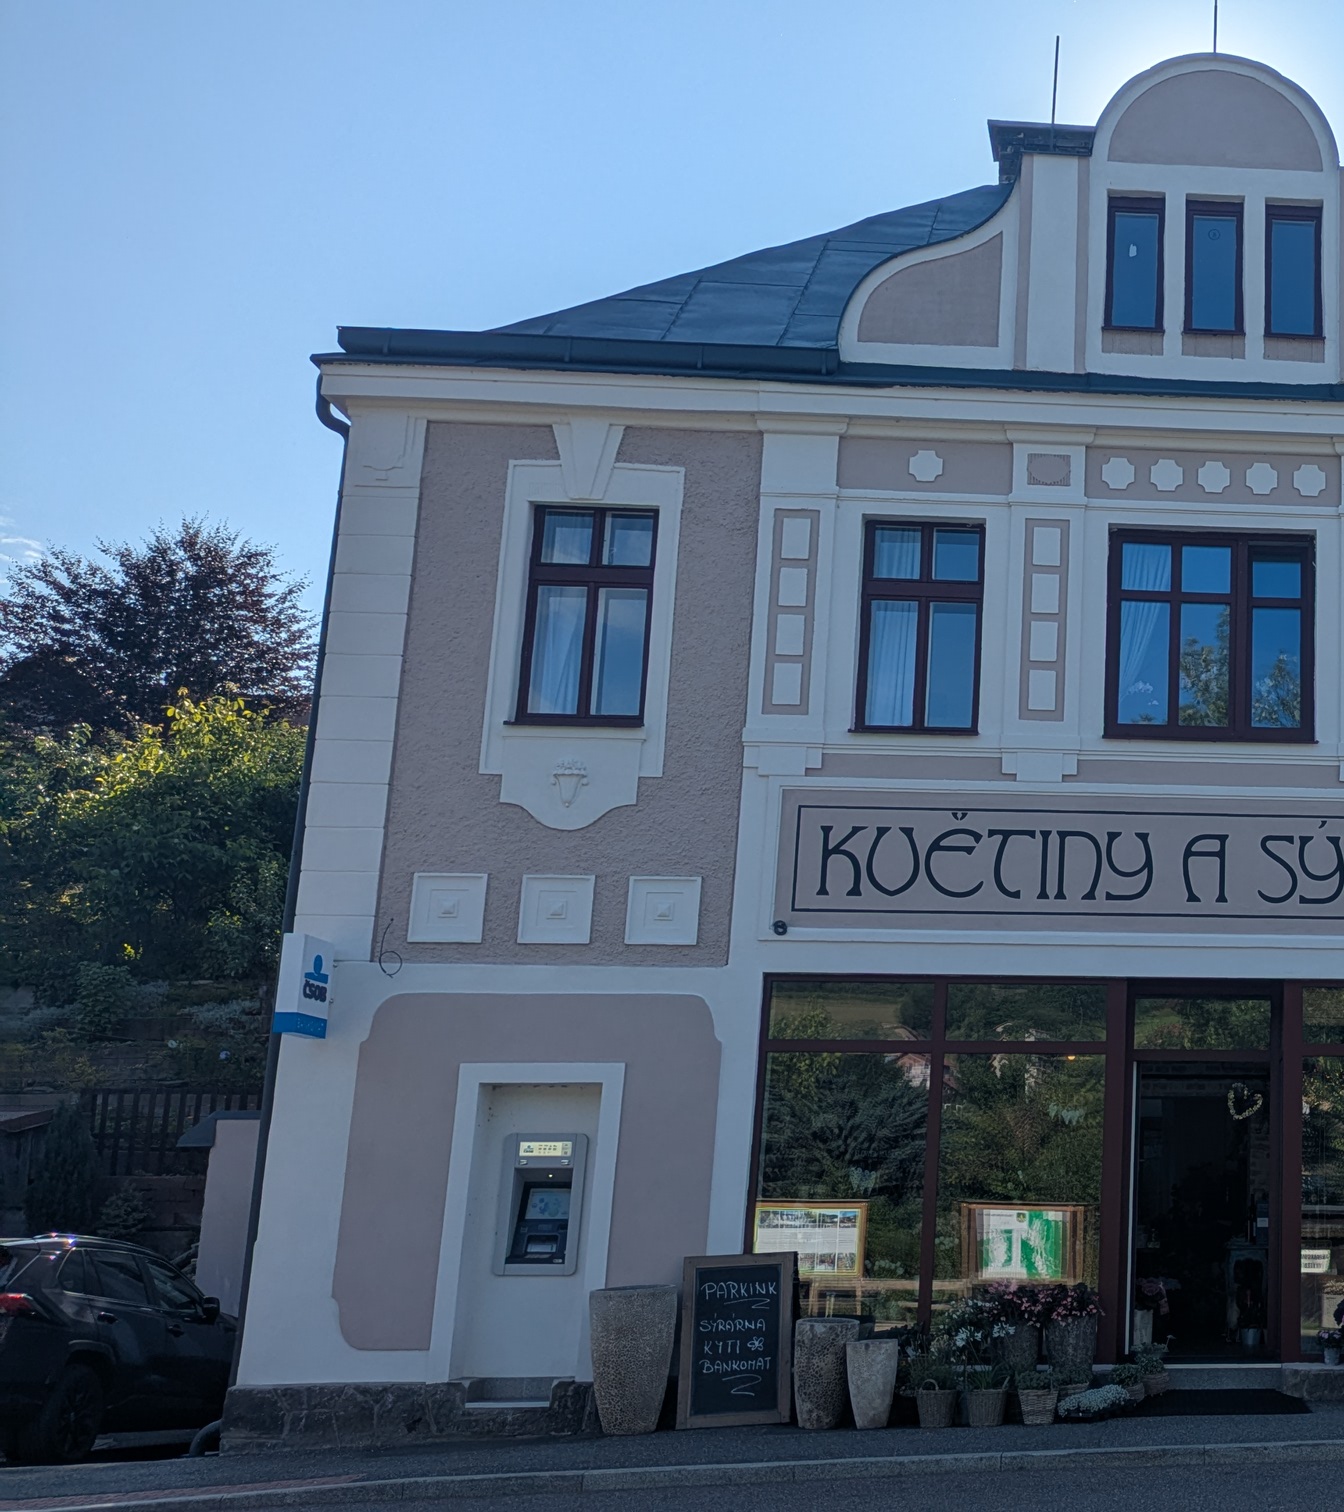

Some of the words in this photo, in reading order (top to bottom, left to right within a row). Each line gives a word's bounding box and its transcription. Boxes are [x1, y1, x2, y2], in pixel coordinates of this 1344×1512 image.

[815, 811, 1154, 901] KVĚTINY
[1182, 833, 1230, 904] A
[302, 979, 328, 1003] ČSOB
[700, 1281, 778, 1300] PARKINK
[699, 1312, 766, 1332] SÝRÁRNA
[703, 1340, 741, 1354] KYTI
[699, 1356, 772, 1374] BANKOMAT
